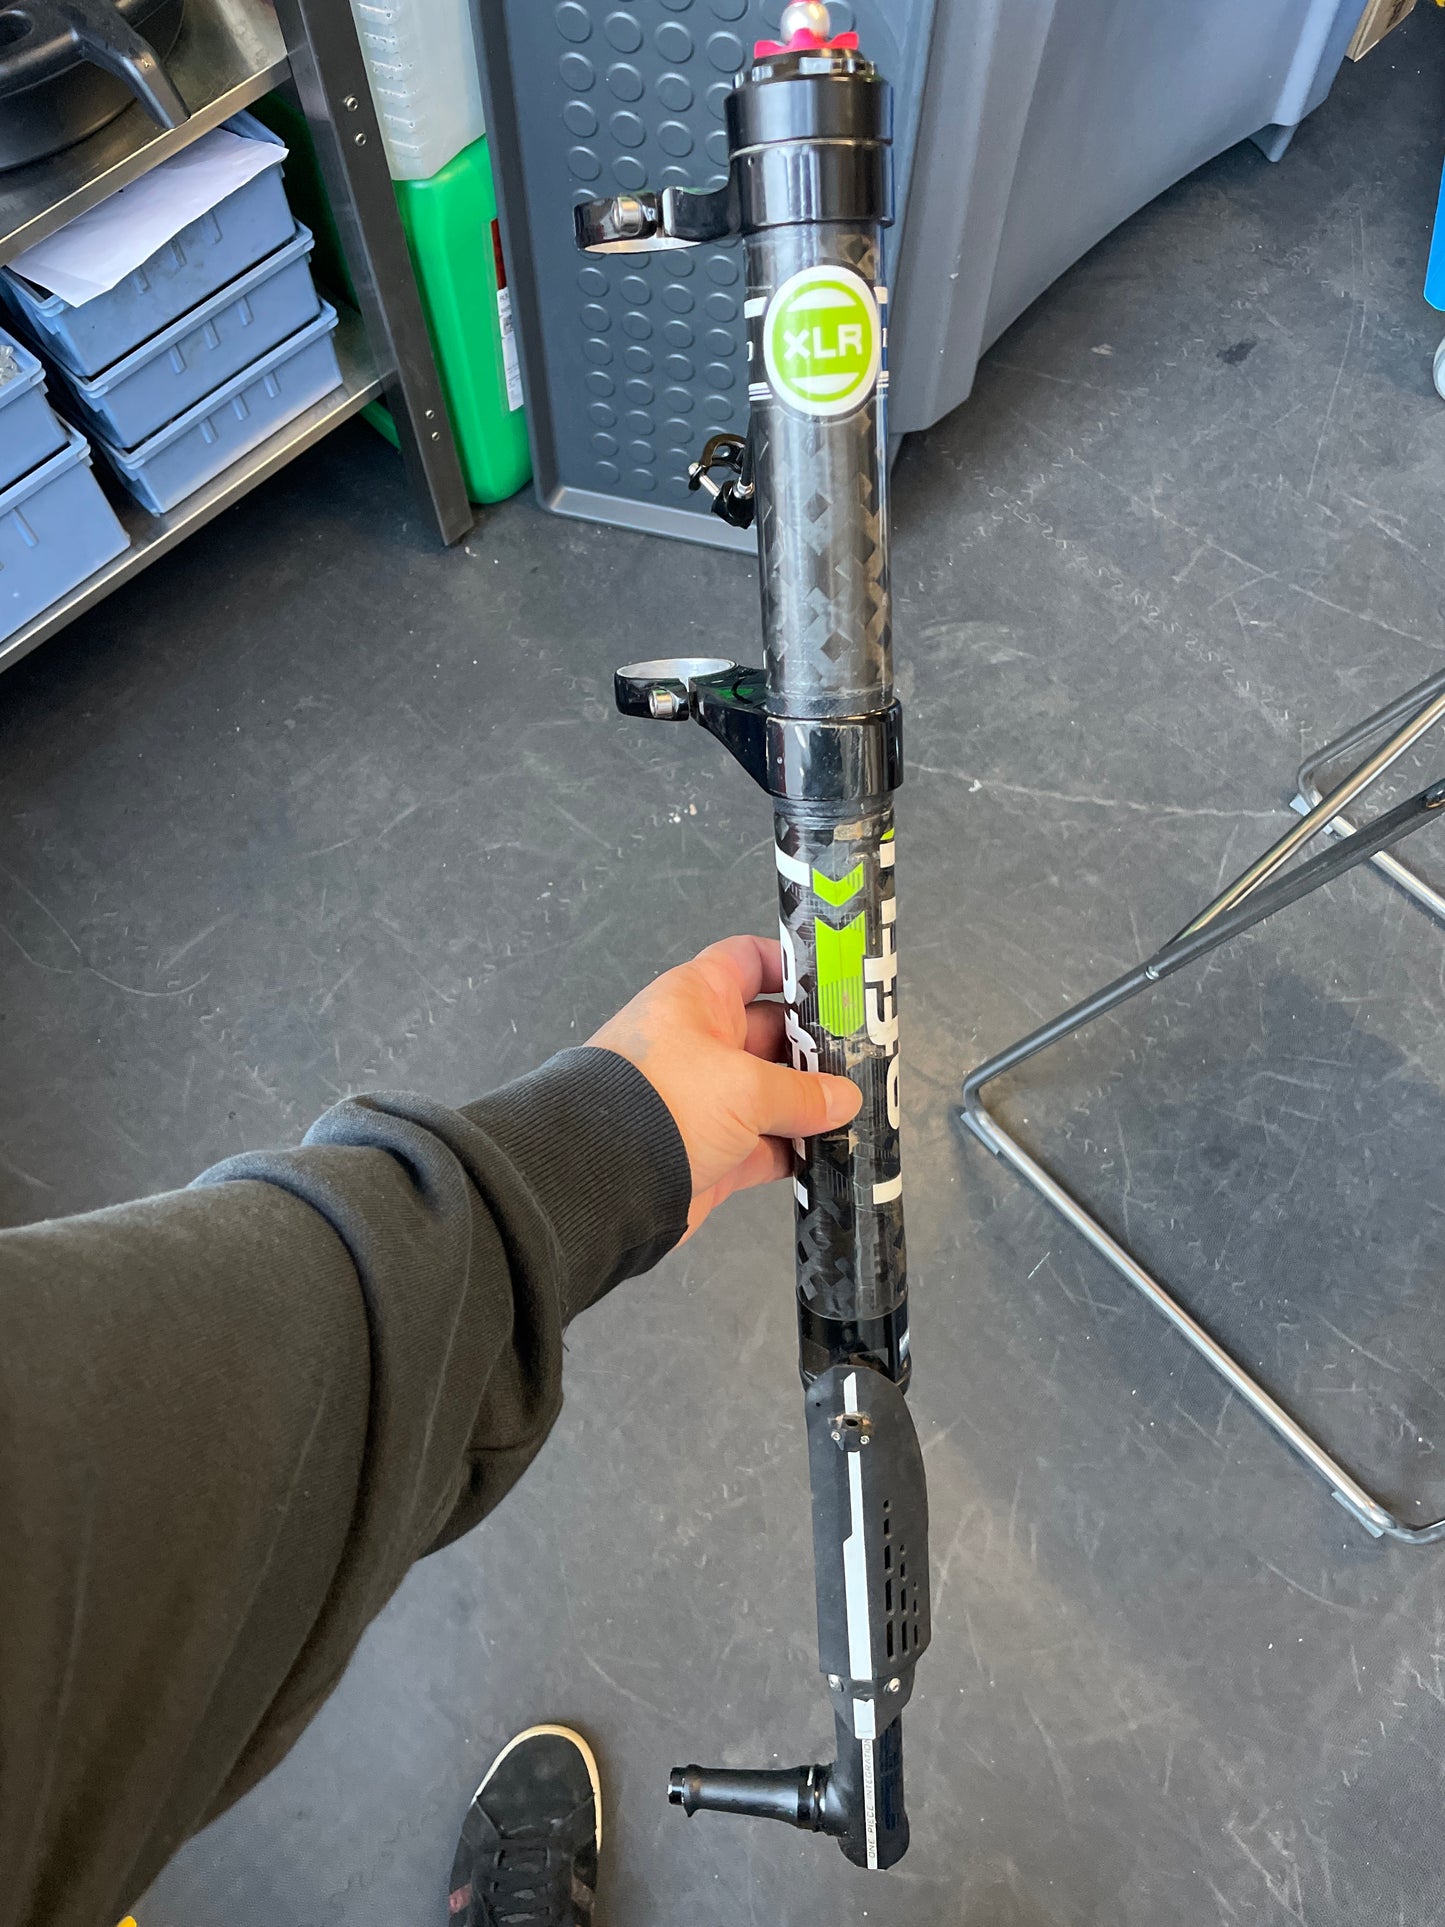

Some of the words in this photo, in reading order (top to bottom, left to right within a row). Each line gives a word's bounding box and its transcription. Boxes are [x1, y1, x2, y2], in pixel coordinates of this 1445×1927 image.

[783, 323, 863, 361] XLR
[867, 1805, 875, 1834] PIECE
[868, 1840, 876, 1859] ONE
